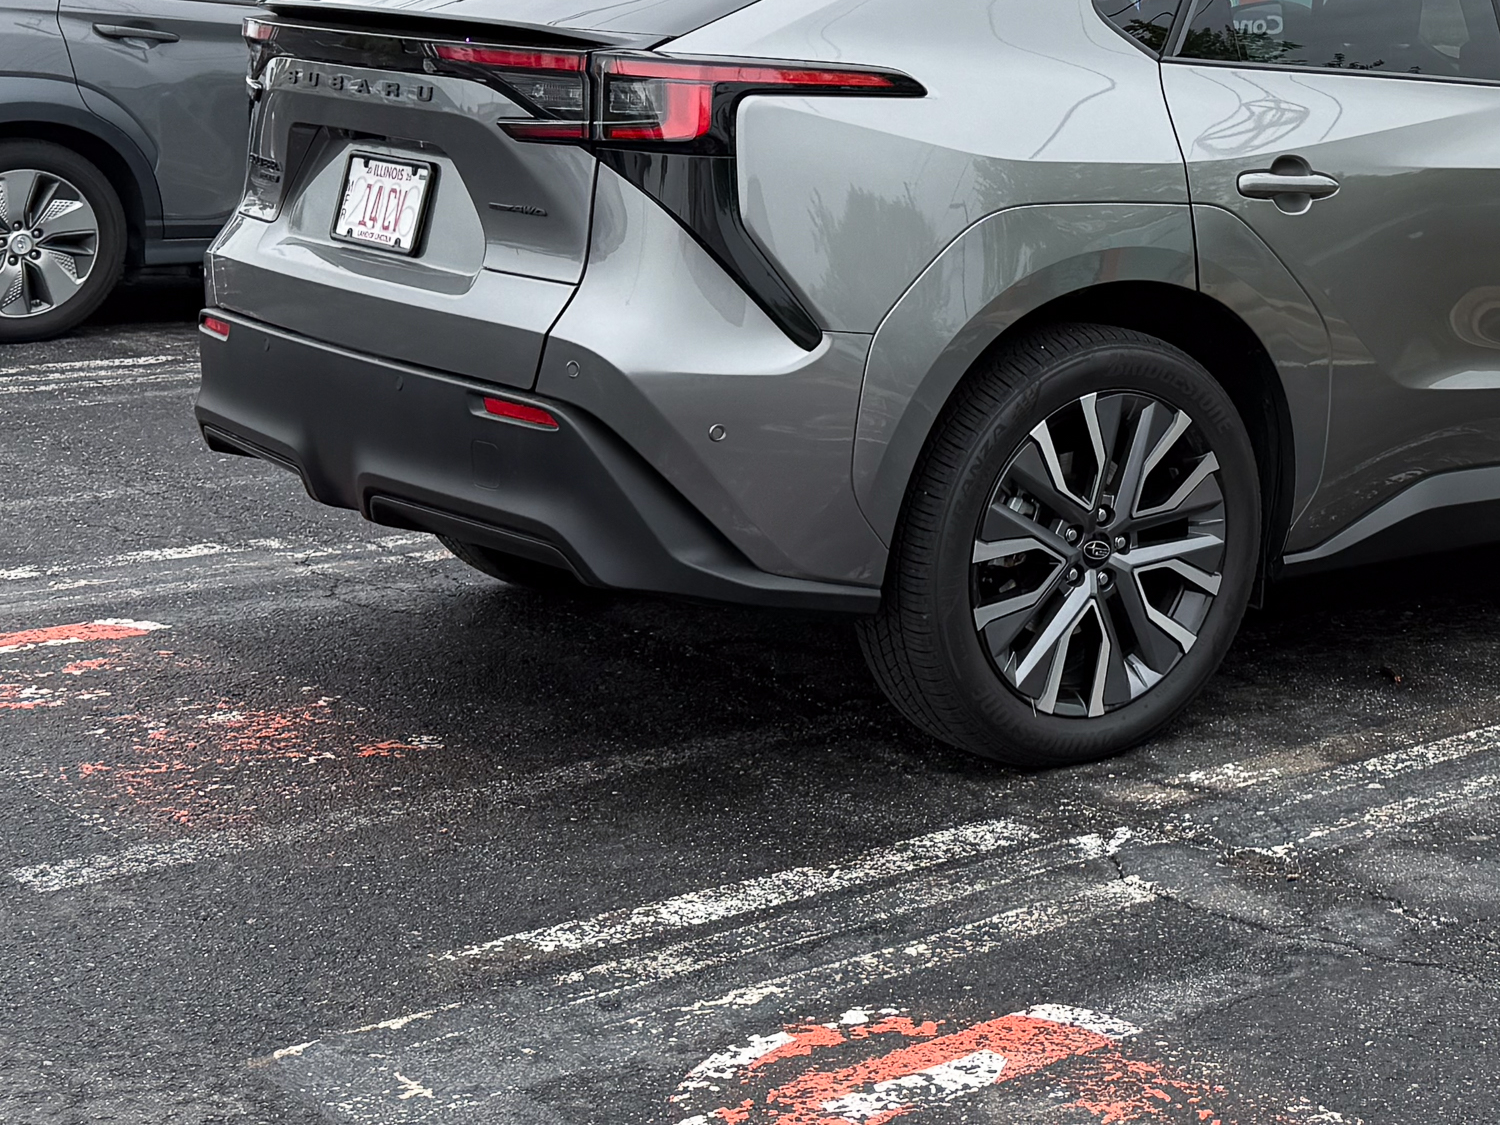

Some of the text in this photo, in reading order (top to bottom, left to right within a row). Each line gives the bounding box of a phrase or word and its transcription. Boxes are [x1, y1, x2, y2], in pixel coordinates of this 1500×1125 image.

[287, 70, 434, 103] SUBARU
[373, 164, 405, 181] ILLINOIS
[358, 183, 408, 233] 14 CV
